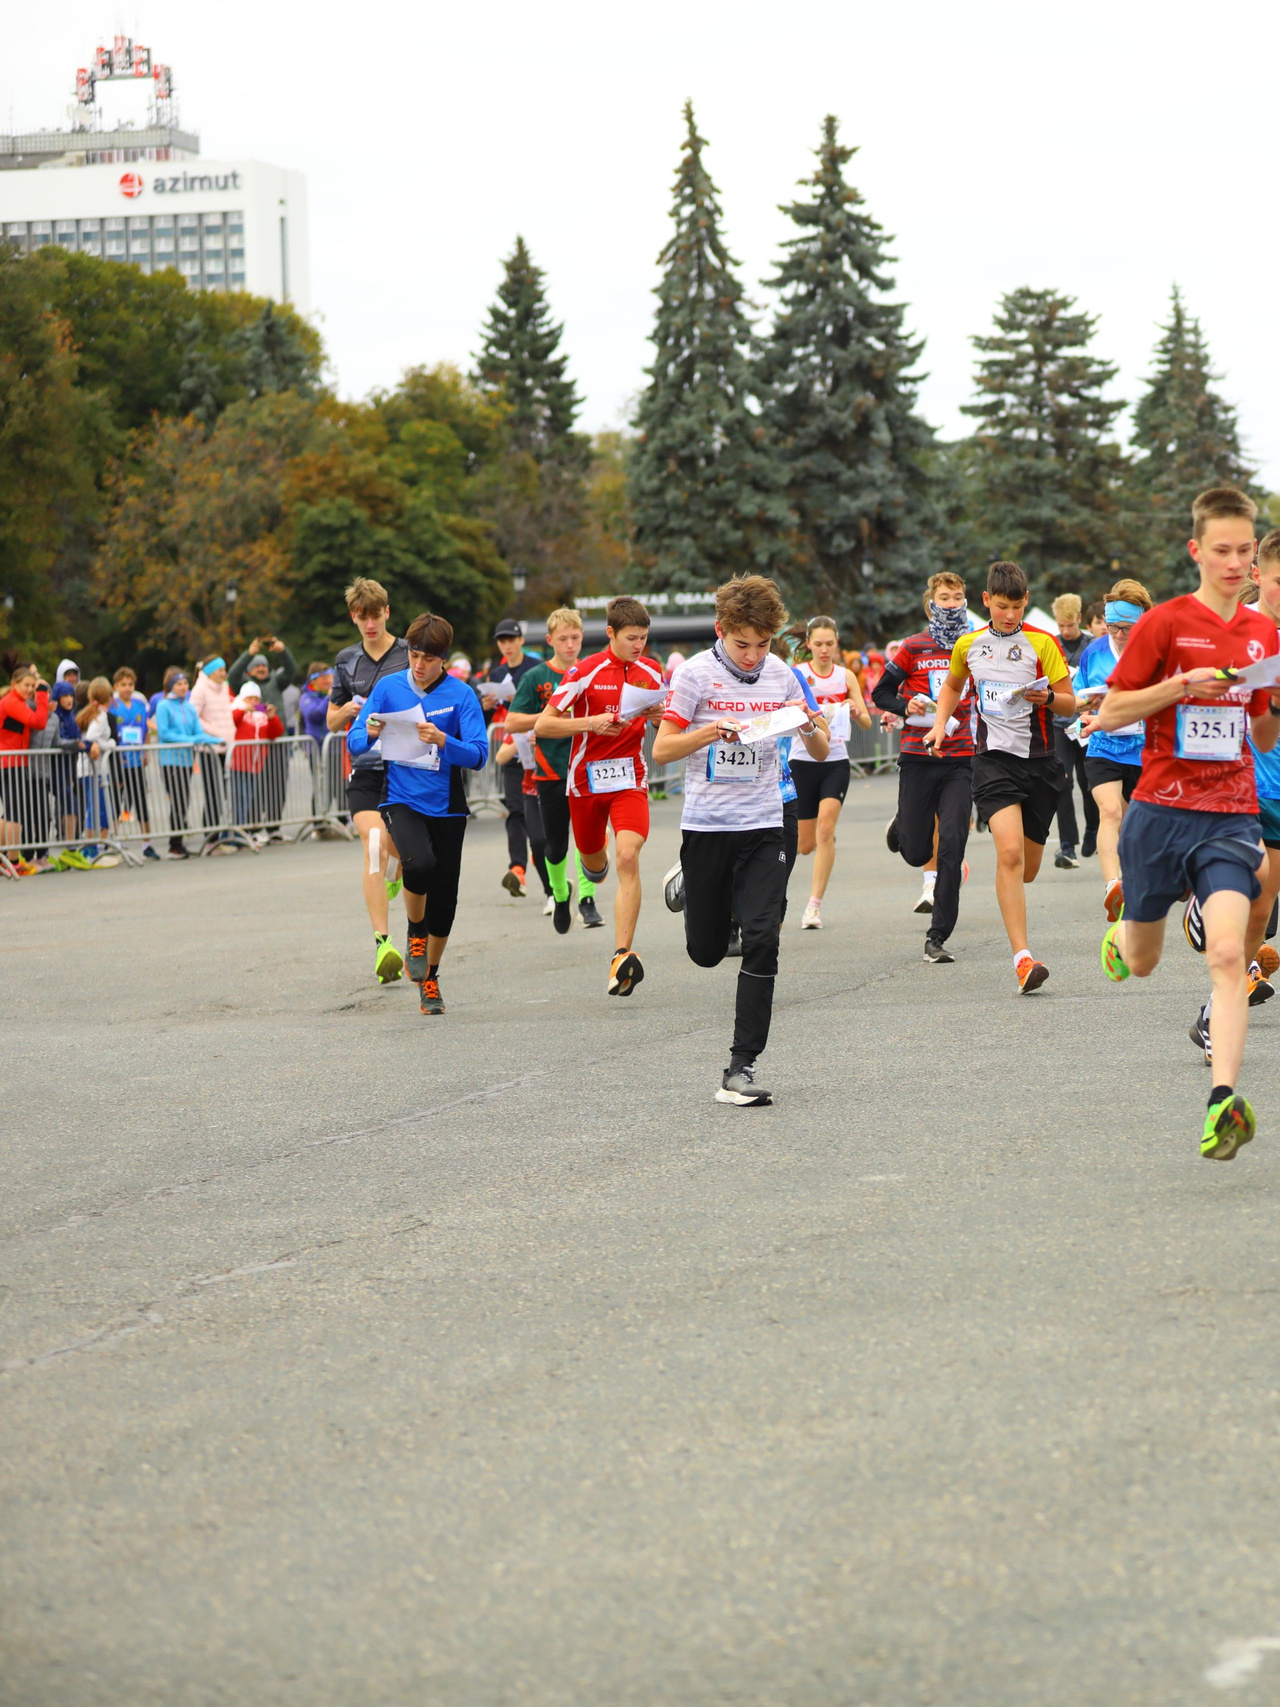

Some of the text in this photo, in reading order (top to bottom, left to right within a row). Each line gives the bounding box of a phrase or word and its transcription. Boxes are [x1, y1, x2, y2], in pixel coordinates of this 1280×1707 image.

[153, 170, 241, 193] azimut
[917, 658, 950, 670] NORD
[708, 700, 784, 713] NORD WES
[1187, 721, 1237, 739] 325.1
[716, 749, 757, 766] 342.1
[594, 766, 628, 781] 322.1
